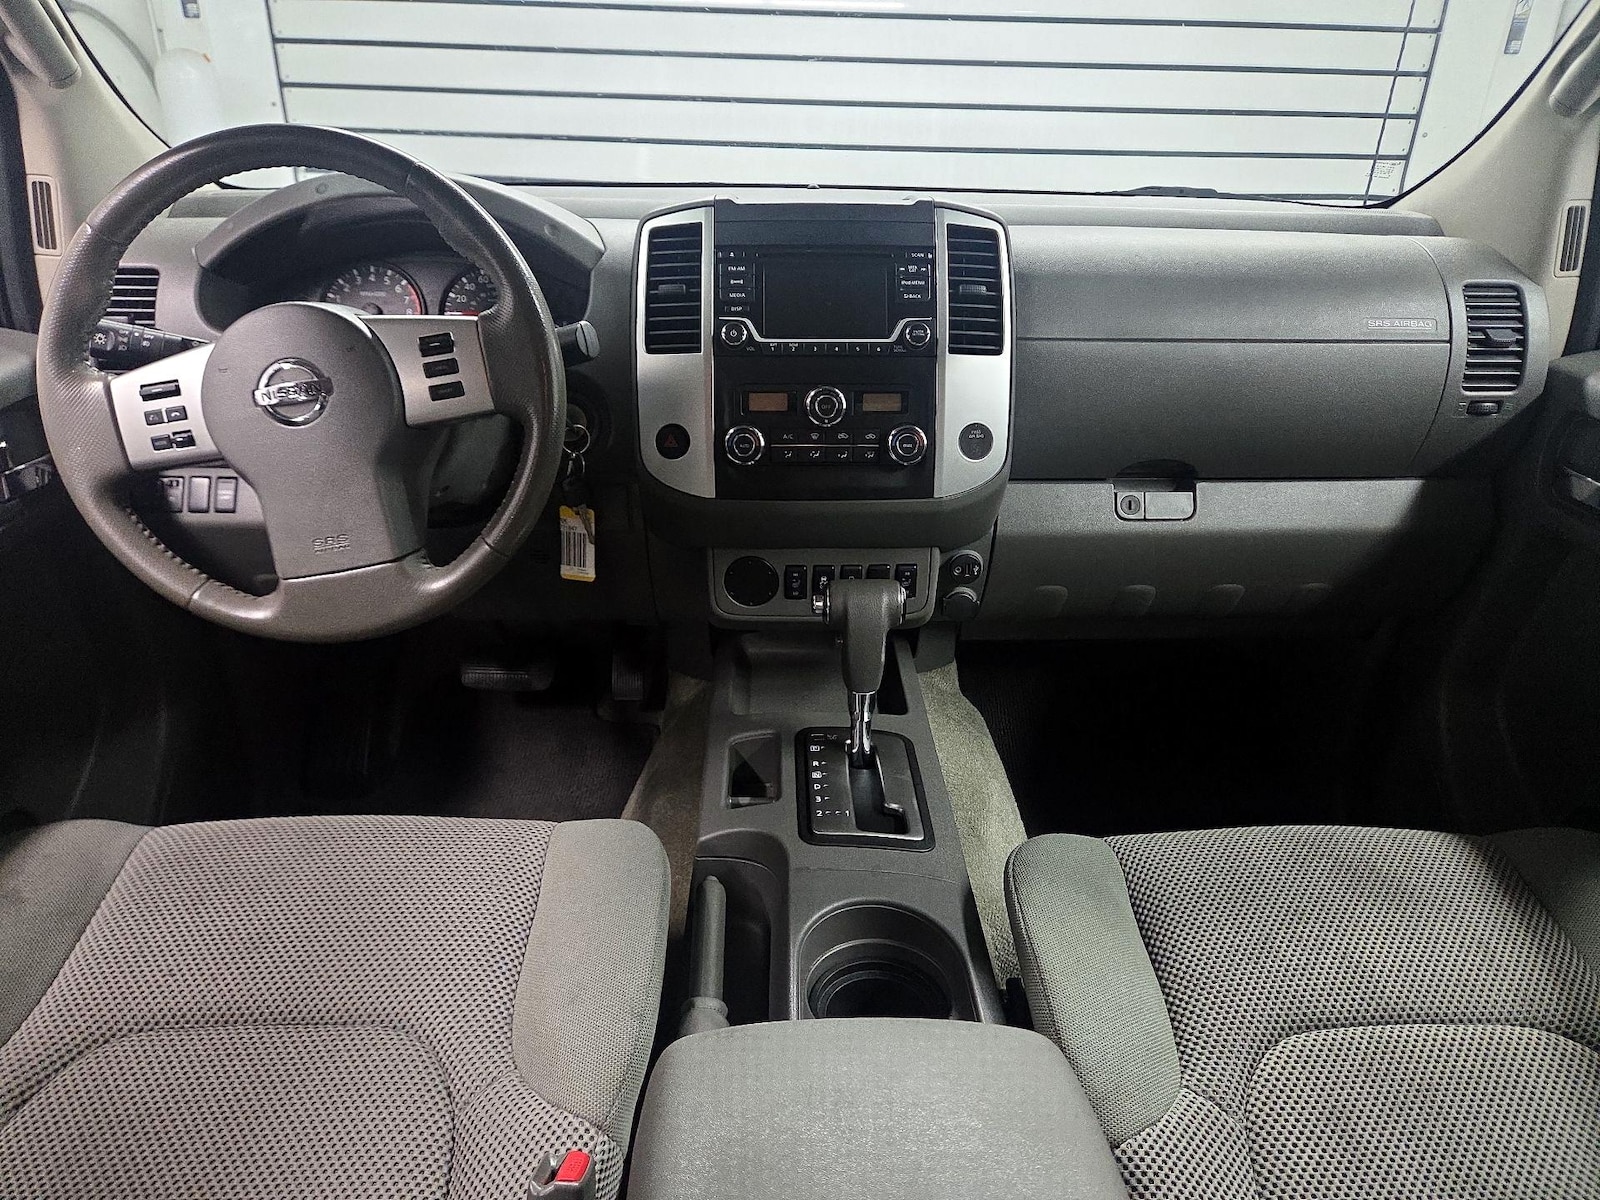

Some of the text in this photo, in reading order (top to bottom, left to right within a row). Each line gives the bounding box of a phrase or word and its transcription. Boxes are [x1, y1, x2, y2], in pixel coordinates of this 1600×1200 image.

[368, 274, 376, 282] 4
[383, 276, 391, 285] 5
[477, 275, 489, 283] 60
[394, 284, 402, 293] 6
[464, 283, 476, 291] 40
[456, 294, 467, 303] 20
[260, 383, 324, 403] NISSAN
[311, 534, 350, 549] SRS
[815, 795, 822, 803] 3
